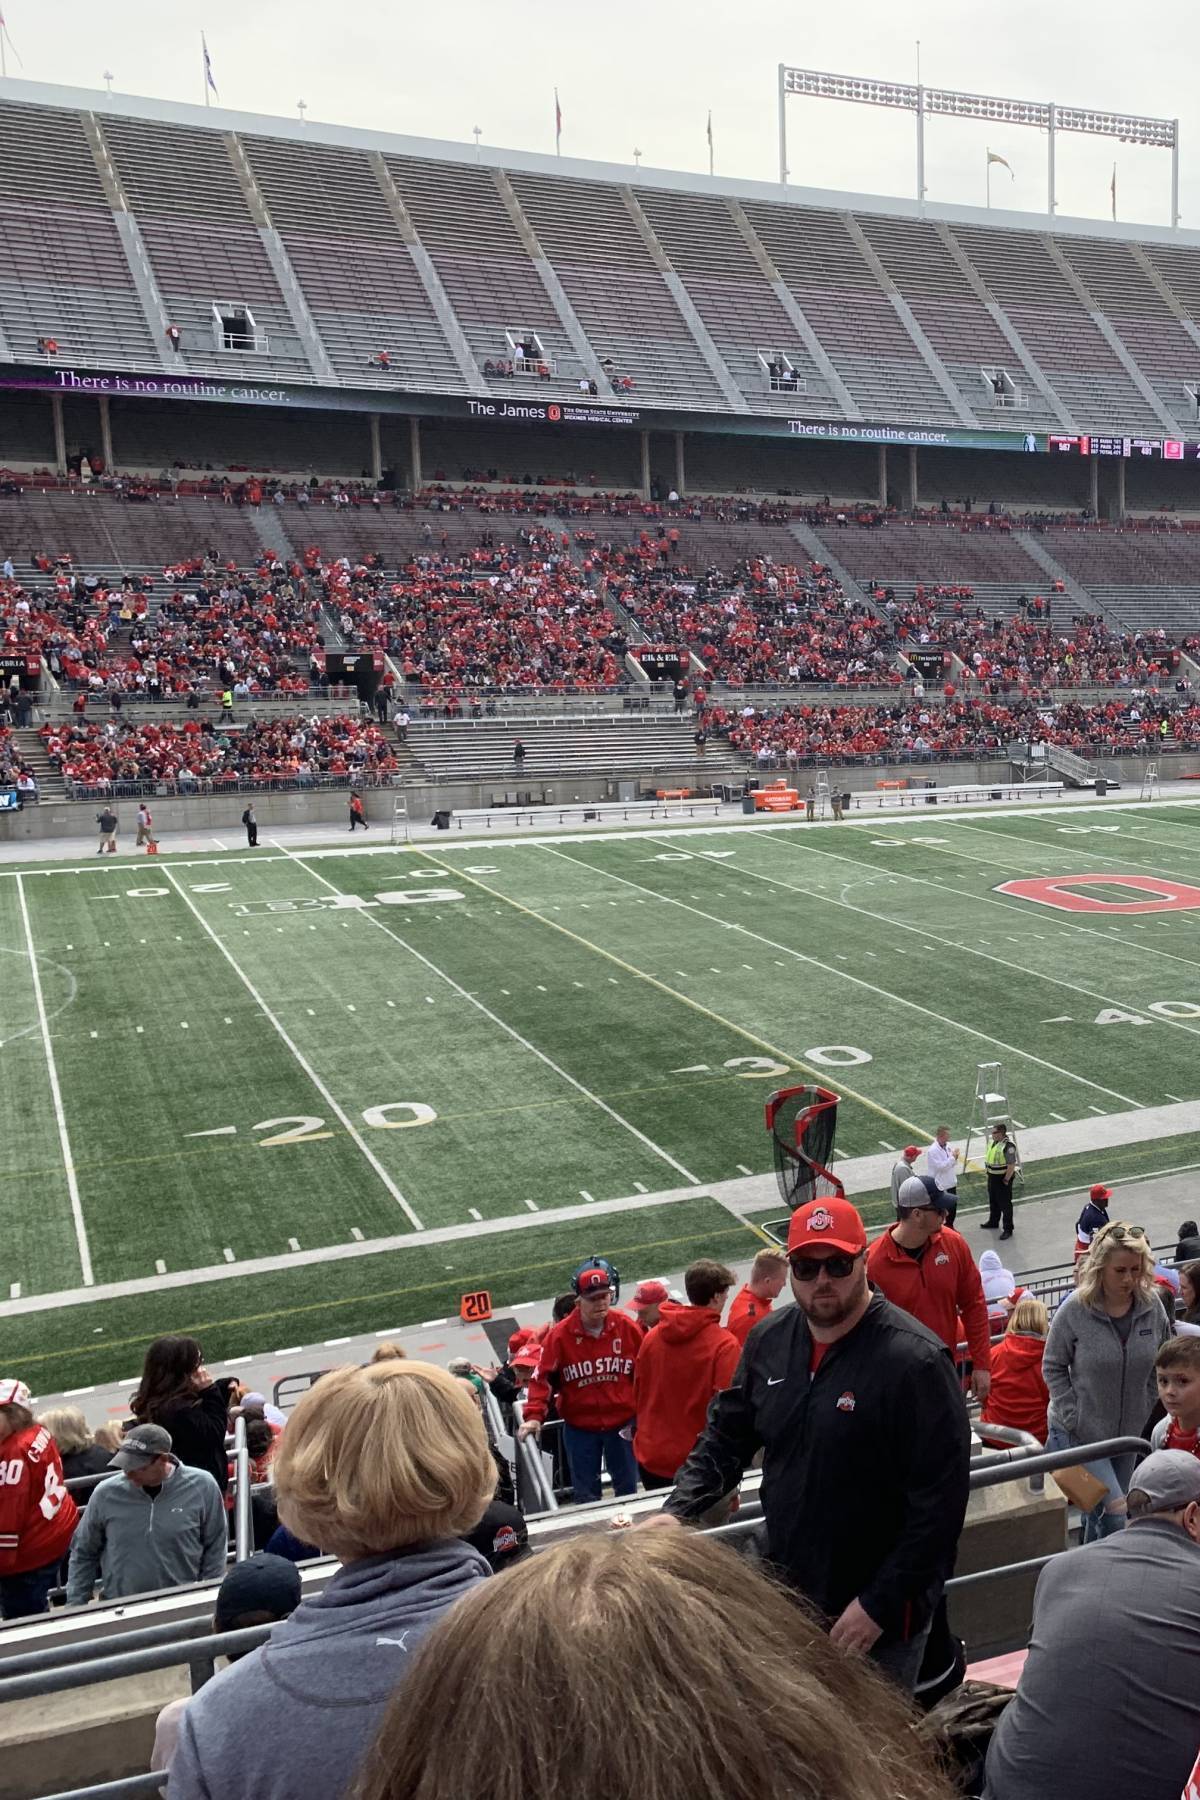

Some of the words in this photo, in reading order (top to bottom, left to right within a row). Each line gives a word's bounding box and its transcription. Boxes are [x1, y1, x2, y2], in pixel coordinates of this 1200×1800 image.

[56, 371, 110, 389] There
[115, 376, 129, 390] is
[135, 379, 157, 392] no
[163, 380, 226, 397] routine
[231, 386, 291, 401] cancer.
[467, 401, 496, 416] The
[499, 403, 546, 419] James
[788, 420, 826, 436] There
[828, 424, 838, 436] is
[842, 426, 857, 437] no
[861, 427, 905, 439] routine
[907, 430, 949, 442] cancer.
[652, 850, 737, 862] 40
[408, 865, 501, 879] 30
[126, 882, 233, 898] 20
[723, 1045, 874, 1079] 30
[251, 1101, 438, 1147] 20
[464, 1293, 489, 1317] 20
[563, 1360, 593, 1383] OHIO
[595, 1356, 634, 1376] STATE
